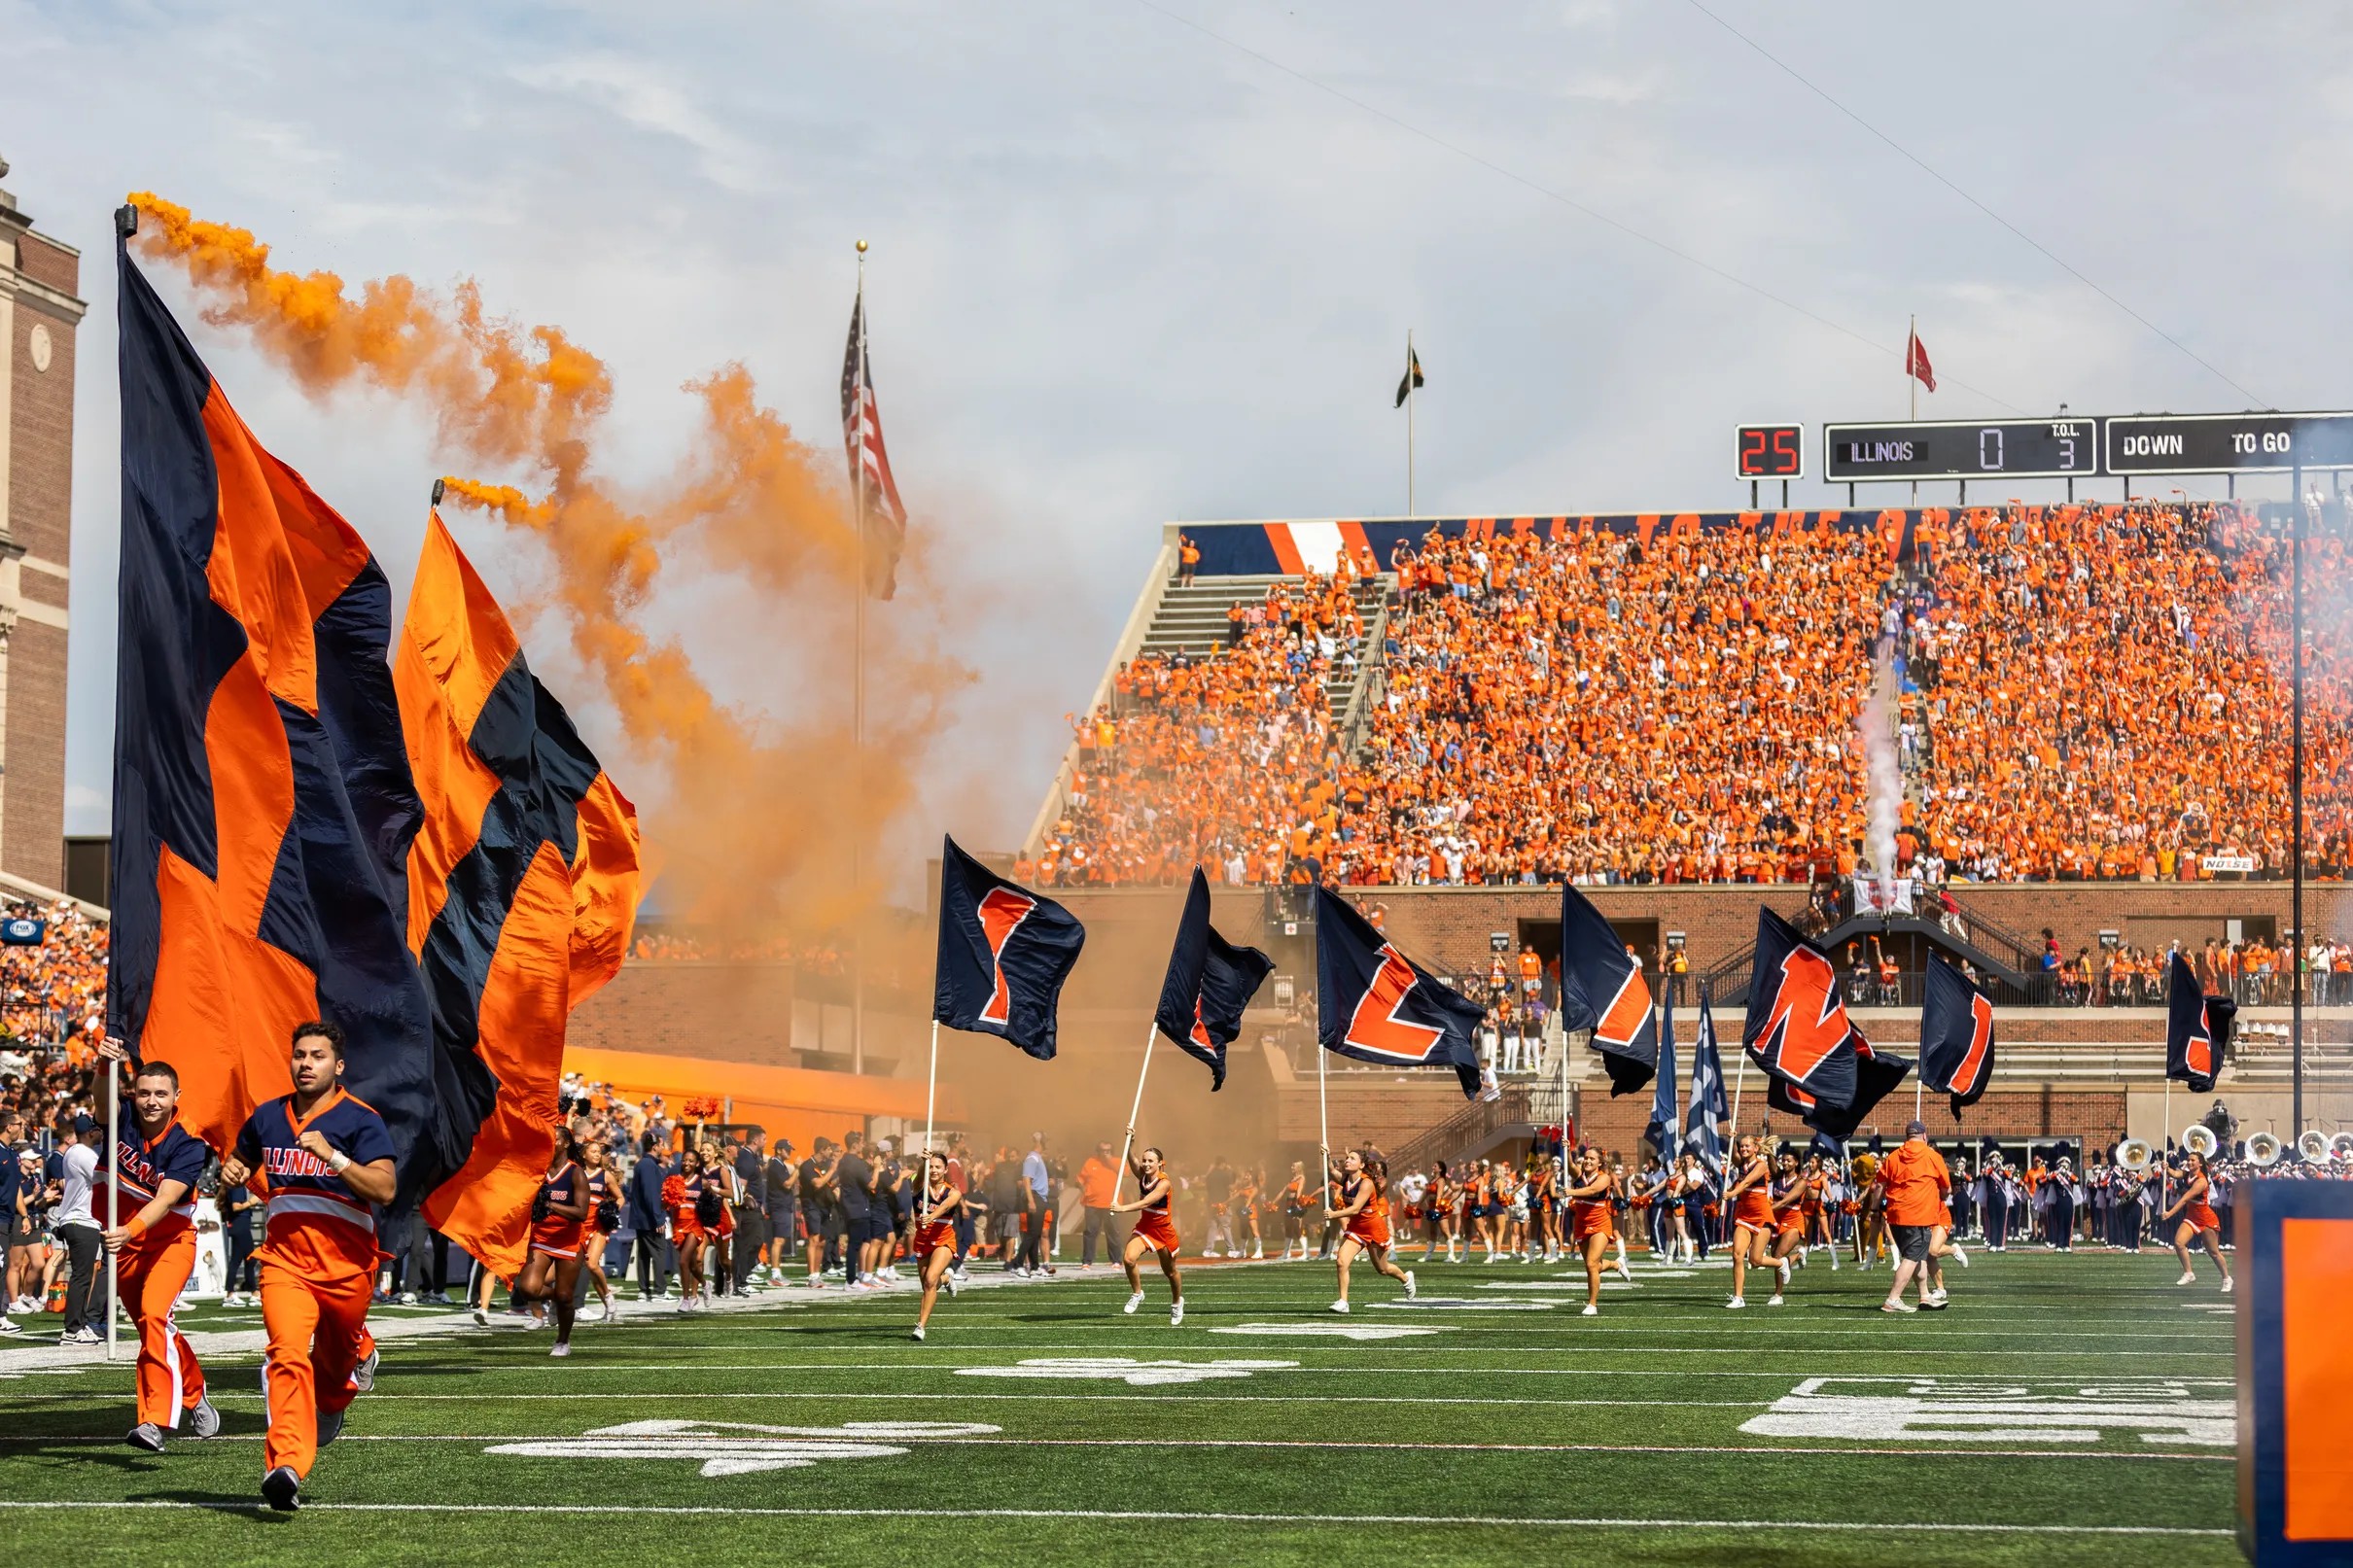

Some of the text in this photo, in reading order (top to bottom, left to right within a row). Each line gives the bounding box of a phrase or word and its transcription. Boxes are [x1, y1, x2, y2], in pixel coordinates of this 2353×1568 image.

[1742, 431, 1797, 472] 25
[1851, 441, 1914, 463] ILLINOIS
[1980, 429, 2003, 470] 0
[2059, 439, 2075, 469] 3
[2124, 432, 2291, 456] DOWN TO GO
[1752, 943, 1850, 1084] N
